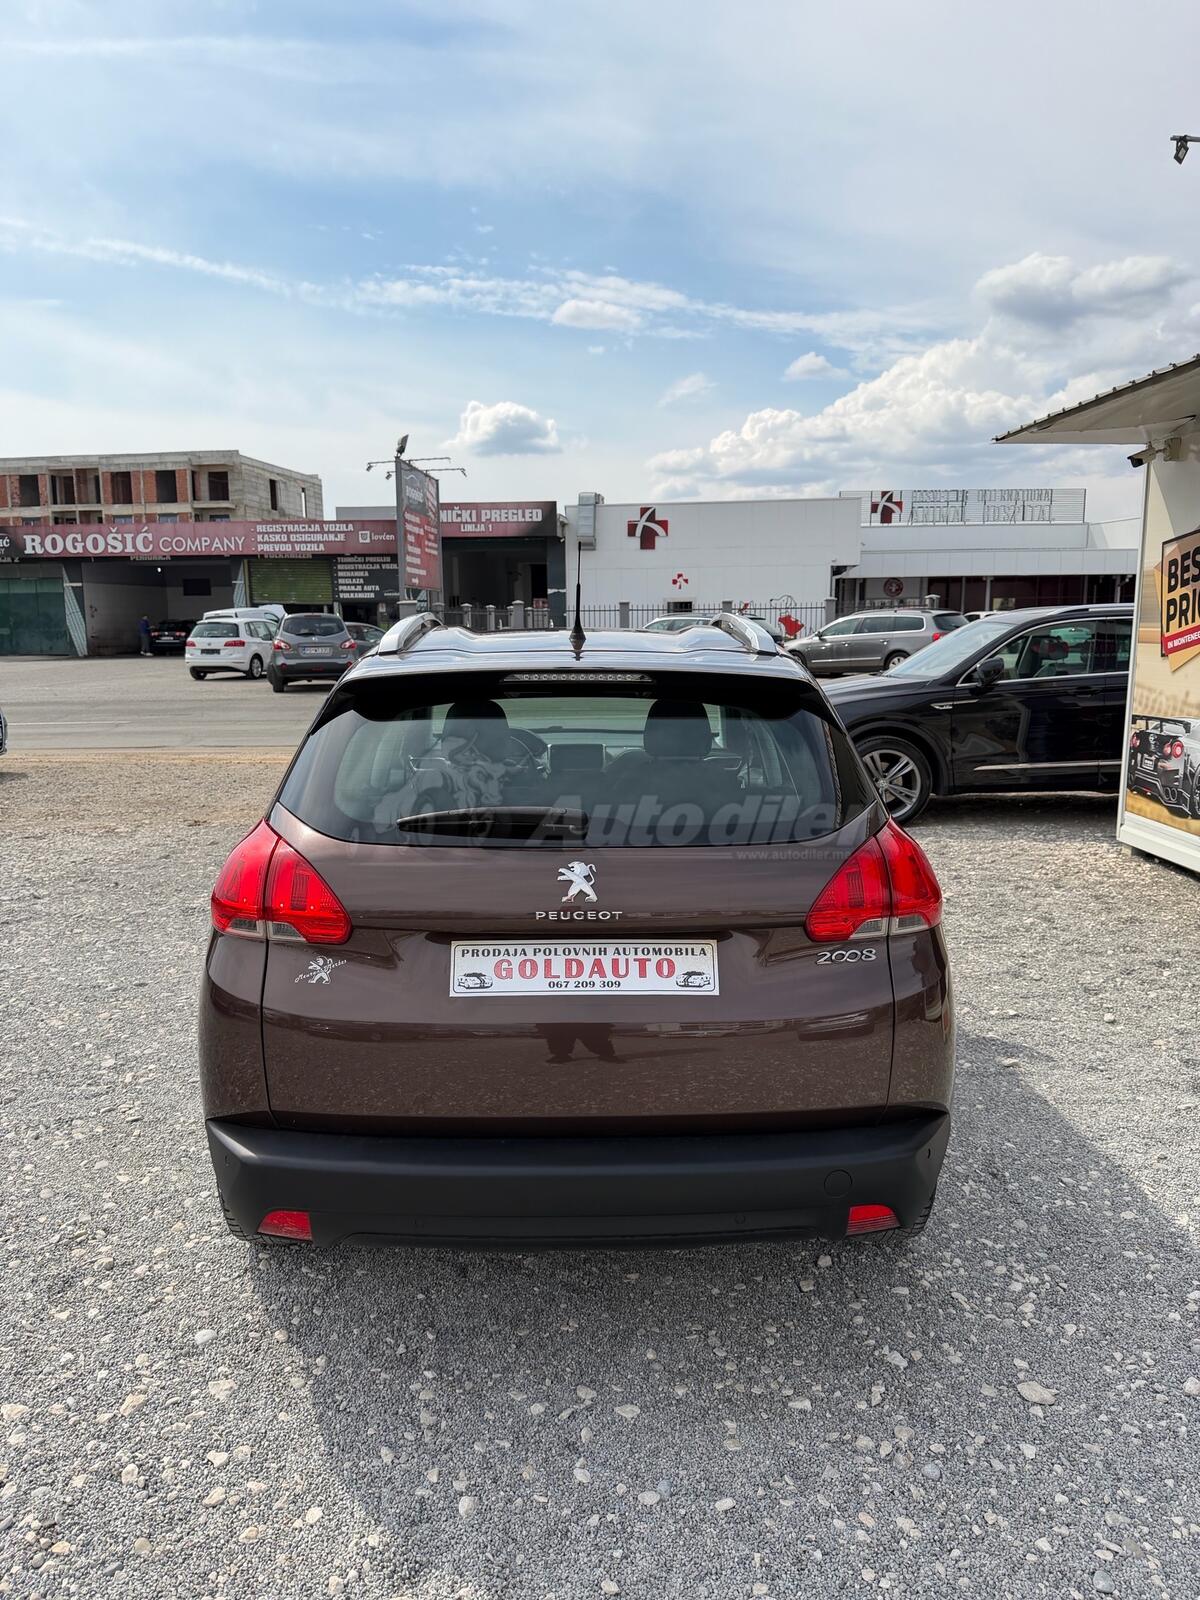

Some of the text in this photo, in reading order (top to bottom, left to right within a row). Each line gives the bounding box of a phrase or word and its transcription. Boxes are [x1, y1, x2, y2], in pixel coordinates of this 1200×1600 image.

[481, 509, 542, 522] PREGLED
[256, 523, 354, 532] REGISTRACIJA VOZILA
[461, 524, 485, 532] LINIJA
[23, 526, 245, 554] ROGOŠIĆ COMPANY
[257, 533, 346, 542] KASKO OSIGURANJE
[257, 543, 325, 552] PREVOD VOZILA
[1166, 588, 1200, 633] PRI
[535, 911, 623, 921] PEUGEOT
[461, 946, 708, 958] PRODAJA POLOVNIH AUTOMOBILA
[816, 949, 877, 965] 2008
[493, 957, 677, 980] GOLDAUTO
[548, 979, 621, 988] 067 209 309
